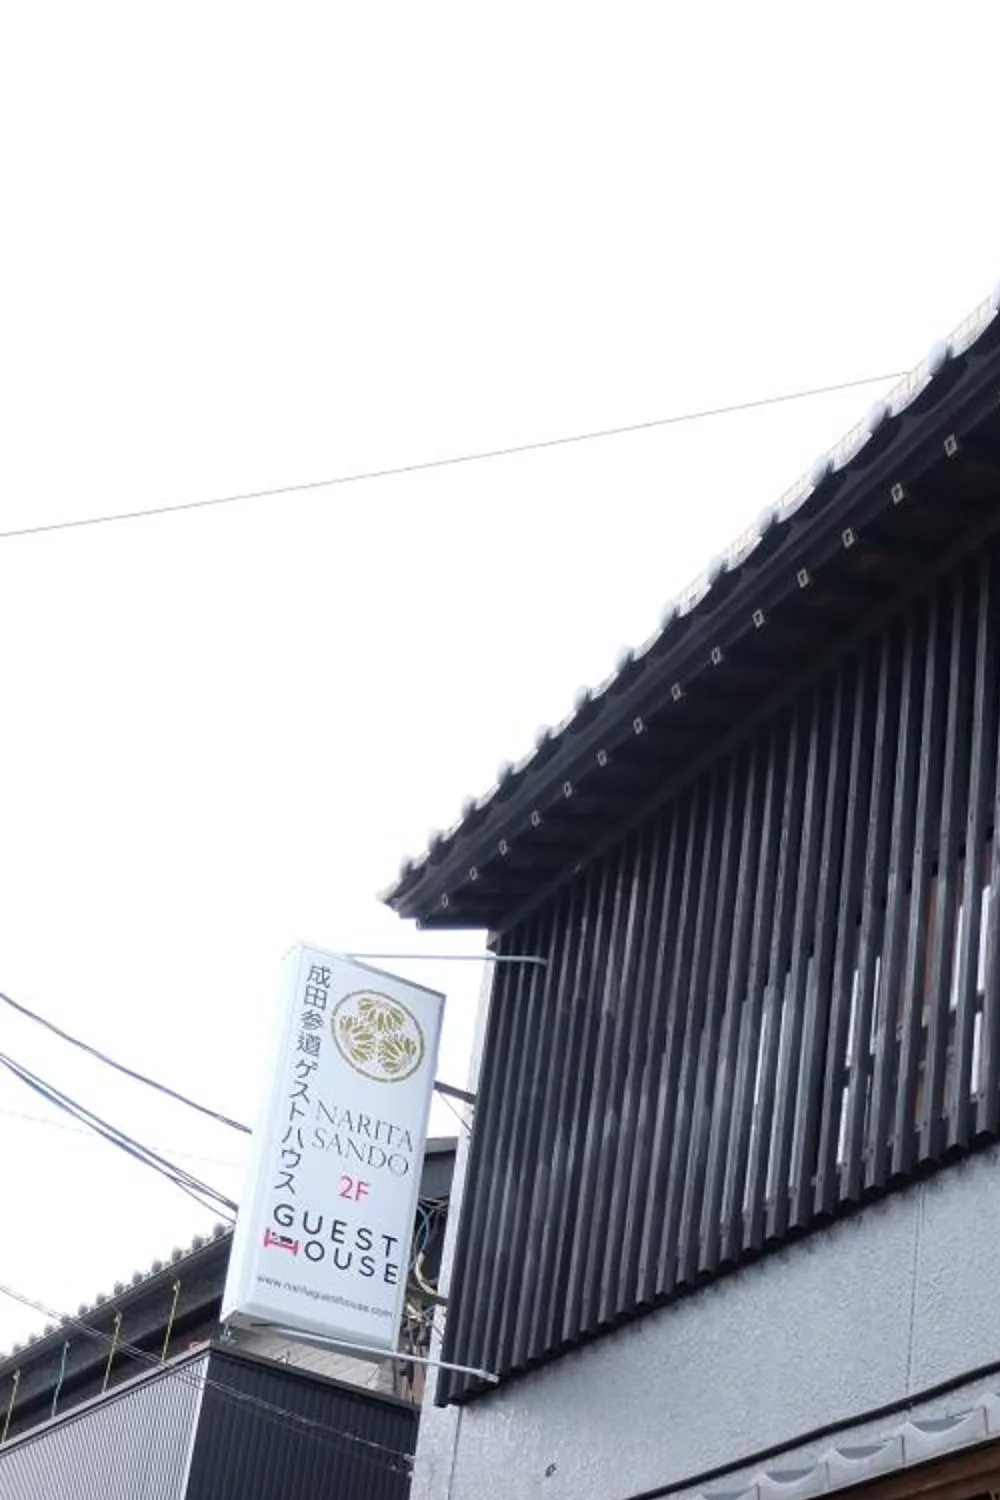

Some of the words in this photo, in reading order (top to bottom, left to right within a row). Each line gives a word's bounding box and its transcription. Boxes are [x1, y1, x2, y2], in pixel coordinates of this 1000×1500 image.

[274, 964, 332, 1196] 成田参道ゲストハウス
[311, 1127, 409, 1177] SANDO
[315, 1099, 415, 1152] NARITA
[338, 1176, 370, 1201] 2F
[273, 1204, 398, 1257] GUEST
